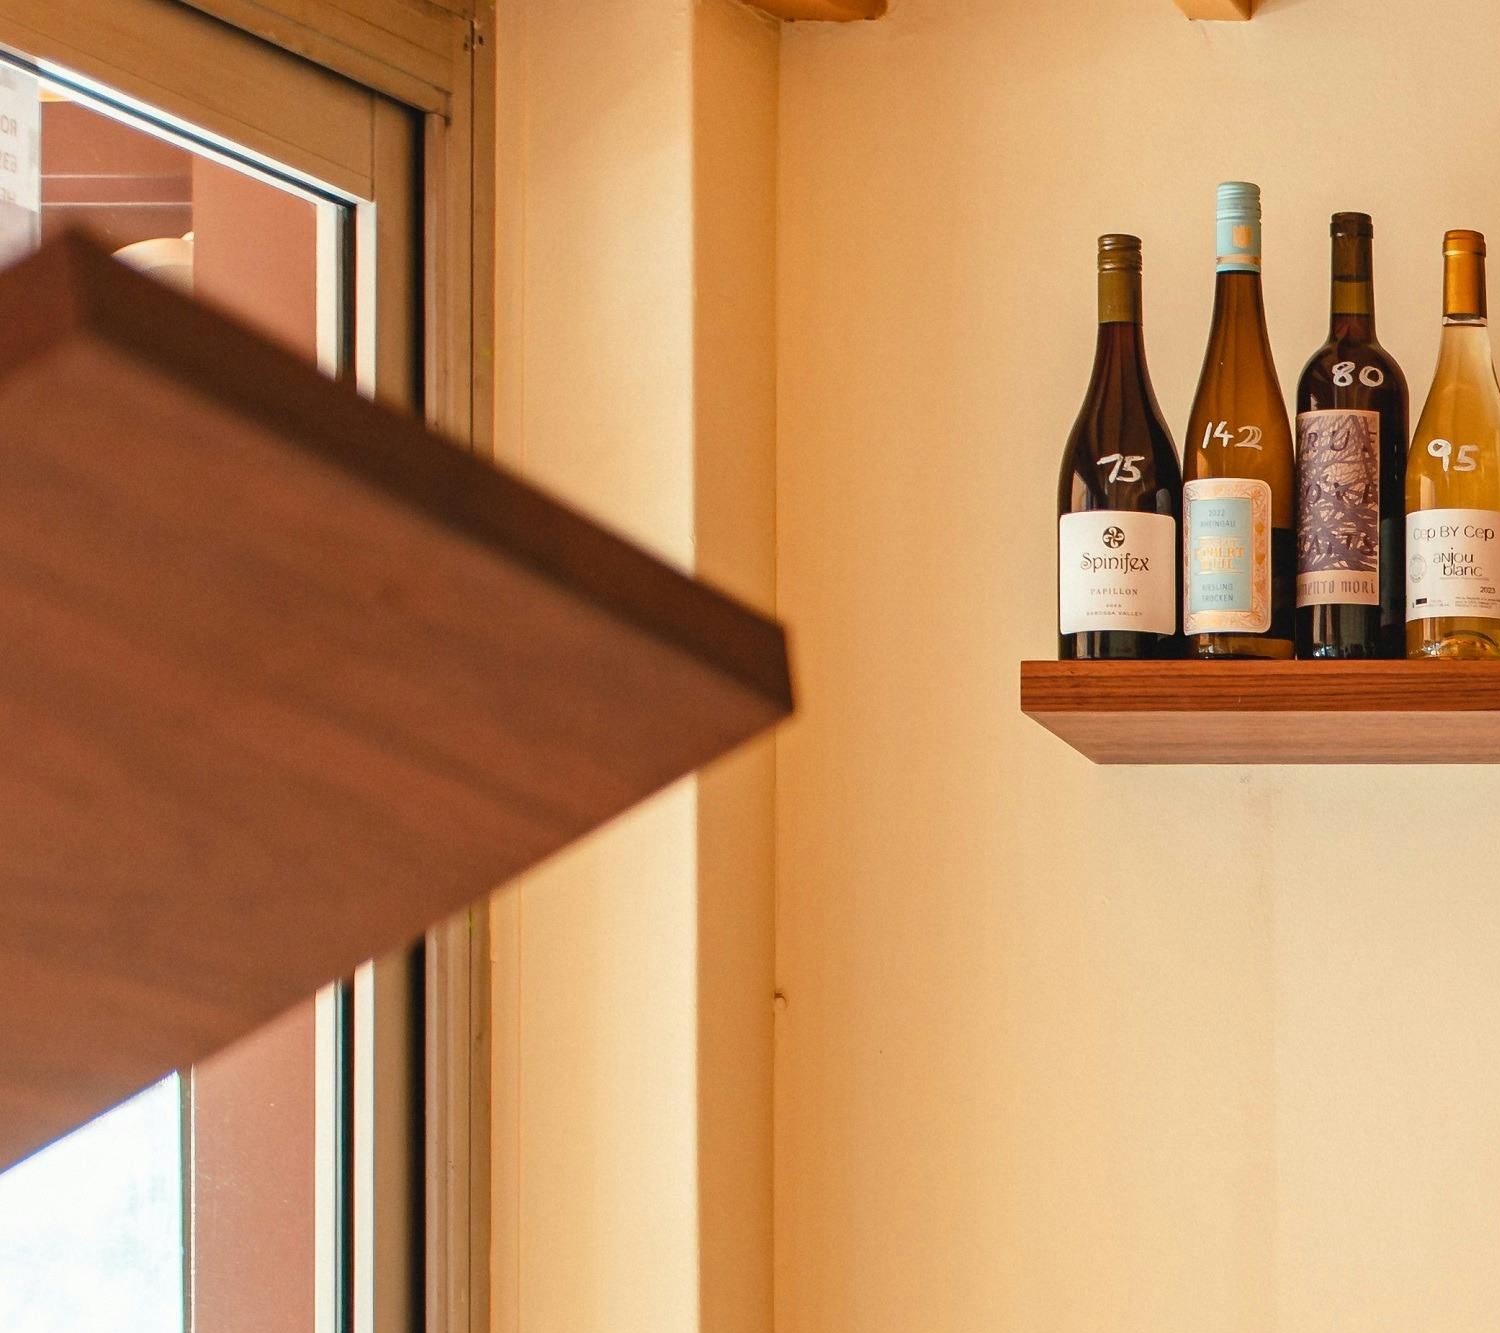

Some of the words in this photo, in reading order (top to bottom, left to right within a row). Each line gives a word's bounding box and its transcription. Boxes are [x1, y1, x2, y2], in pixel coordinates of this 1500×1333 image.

[1332, 361, 1385, 387] 80
[1427, 438, 1479, 473] 95
[1096, 453, 1145, 484] 75
[1440, 525, 1460, 539] BY
[1464, 525, 1495, 542] Cep
[1080, 552, 1150, 575] Spinifex
[1443, 564, 1483, 577] blanc
[1089, 587, 1139, 596] PAPILLON
